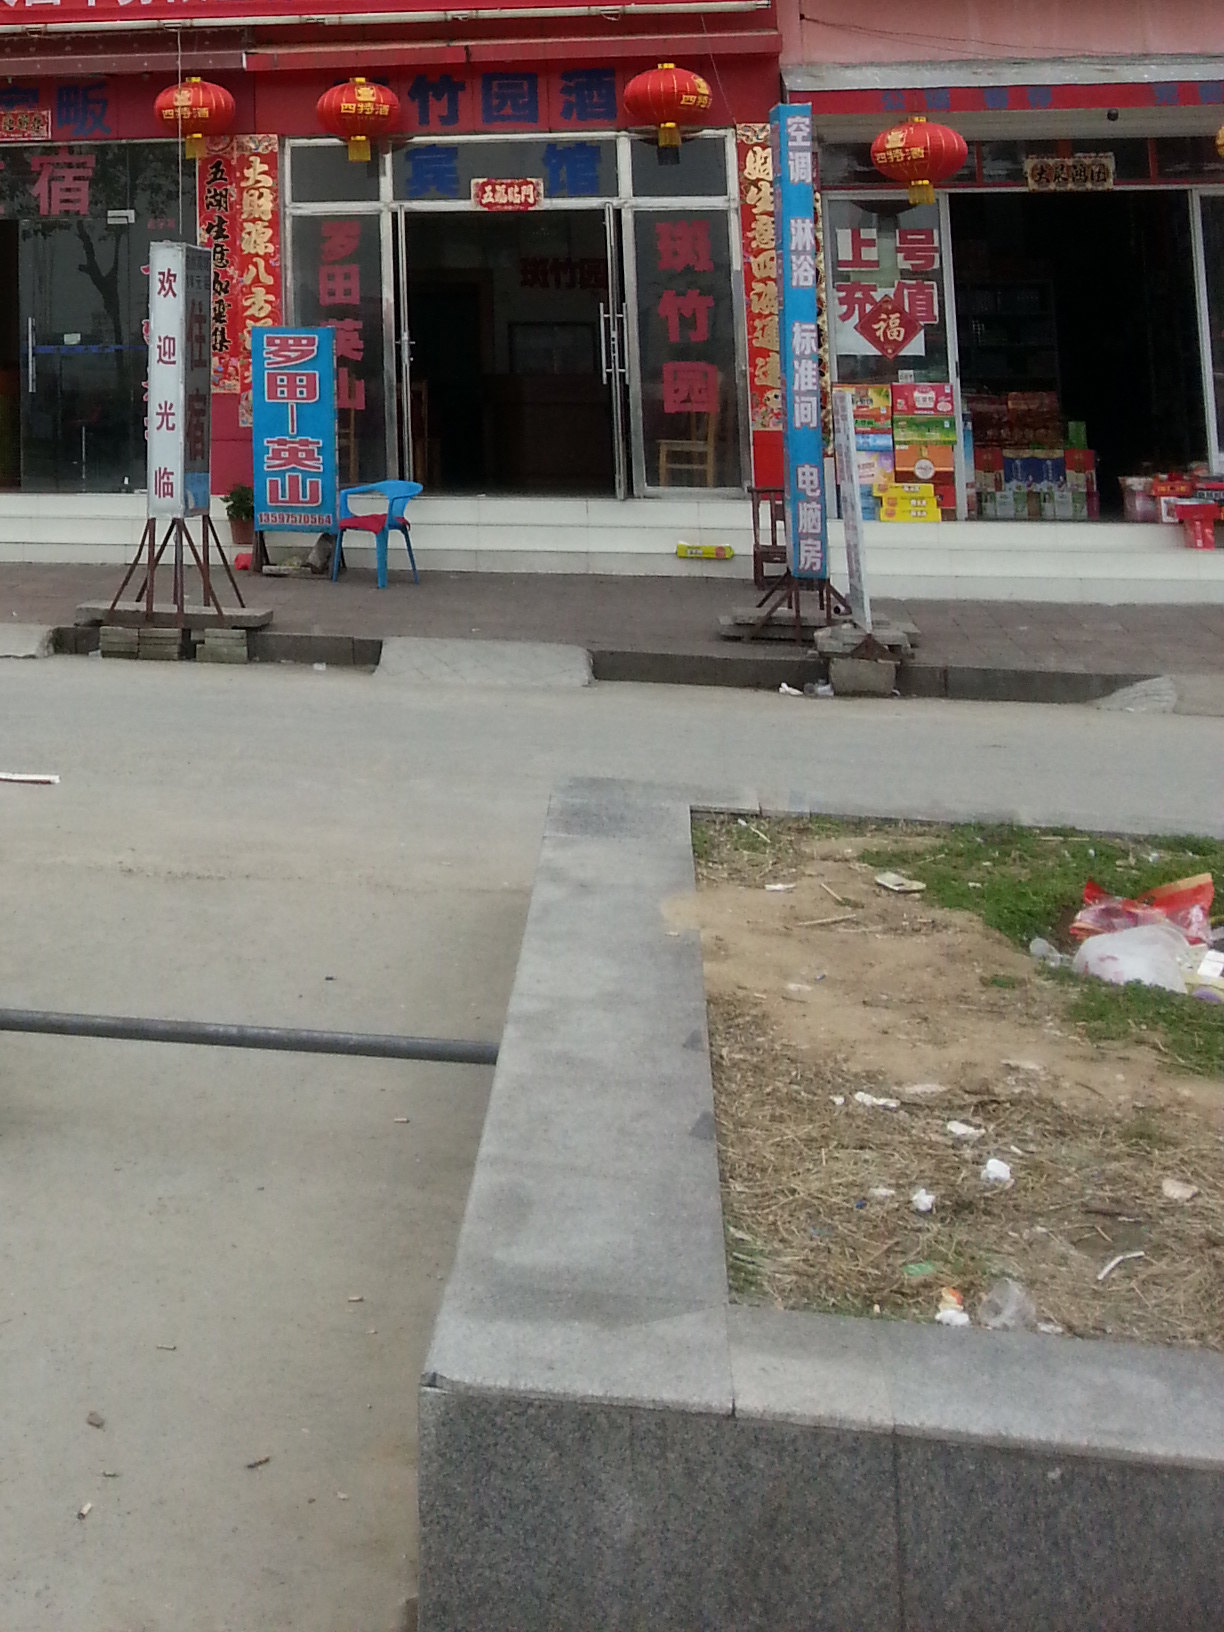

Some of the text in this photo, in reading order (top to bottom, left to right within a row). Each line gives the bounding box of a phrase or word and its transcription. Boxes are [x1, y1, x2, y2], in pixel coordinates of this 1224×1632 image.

[333, 68, 618, 127] 竹园酒
[836, 227, 940, 271] 上号
[656, 219, 720, 414] 斑竹园
[786, 115, 824, 572] 空调 淋浴 标准间 电脑房
[872, 312, 907, 343] 福
[153, 267, 178, 499] 欢迎光临
